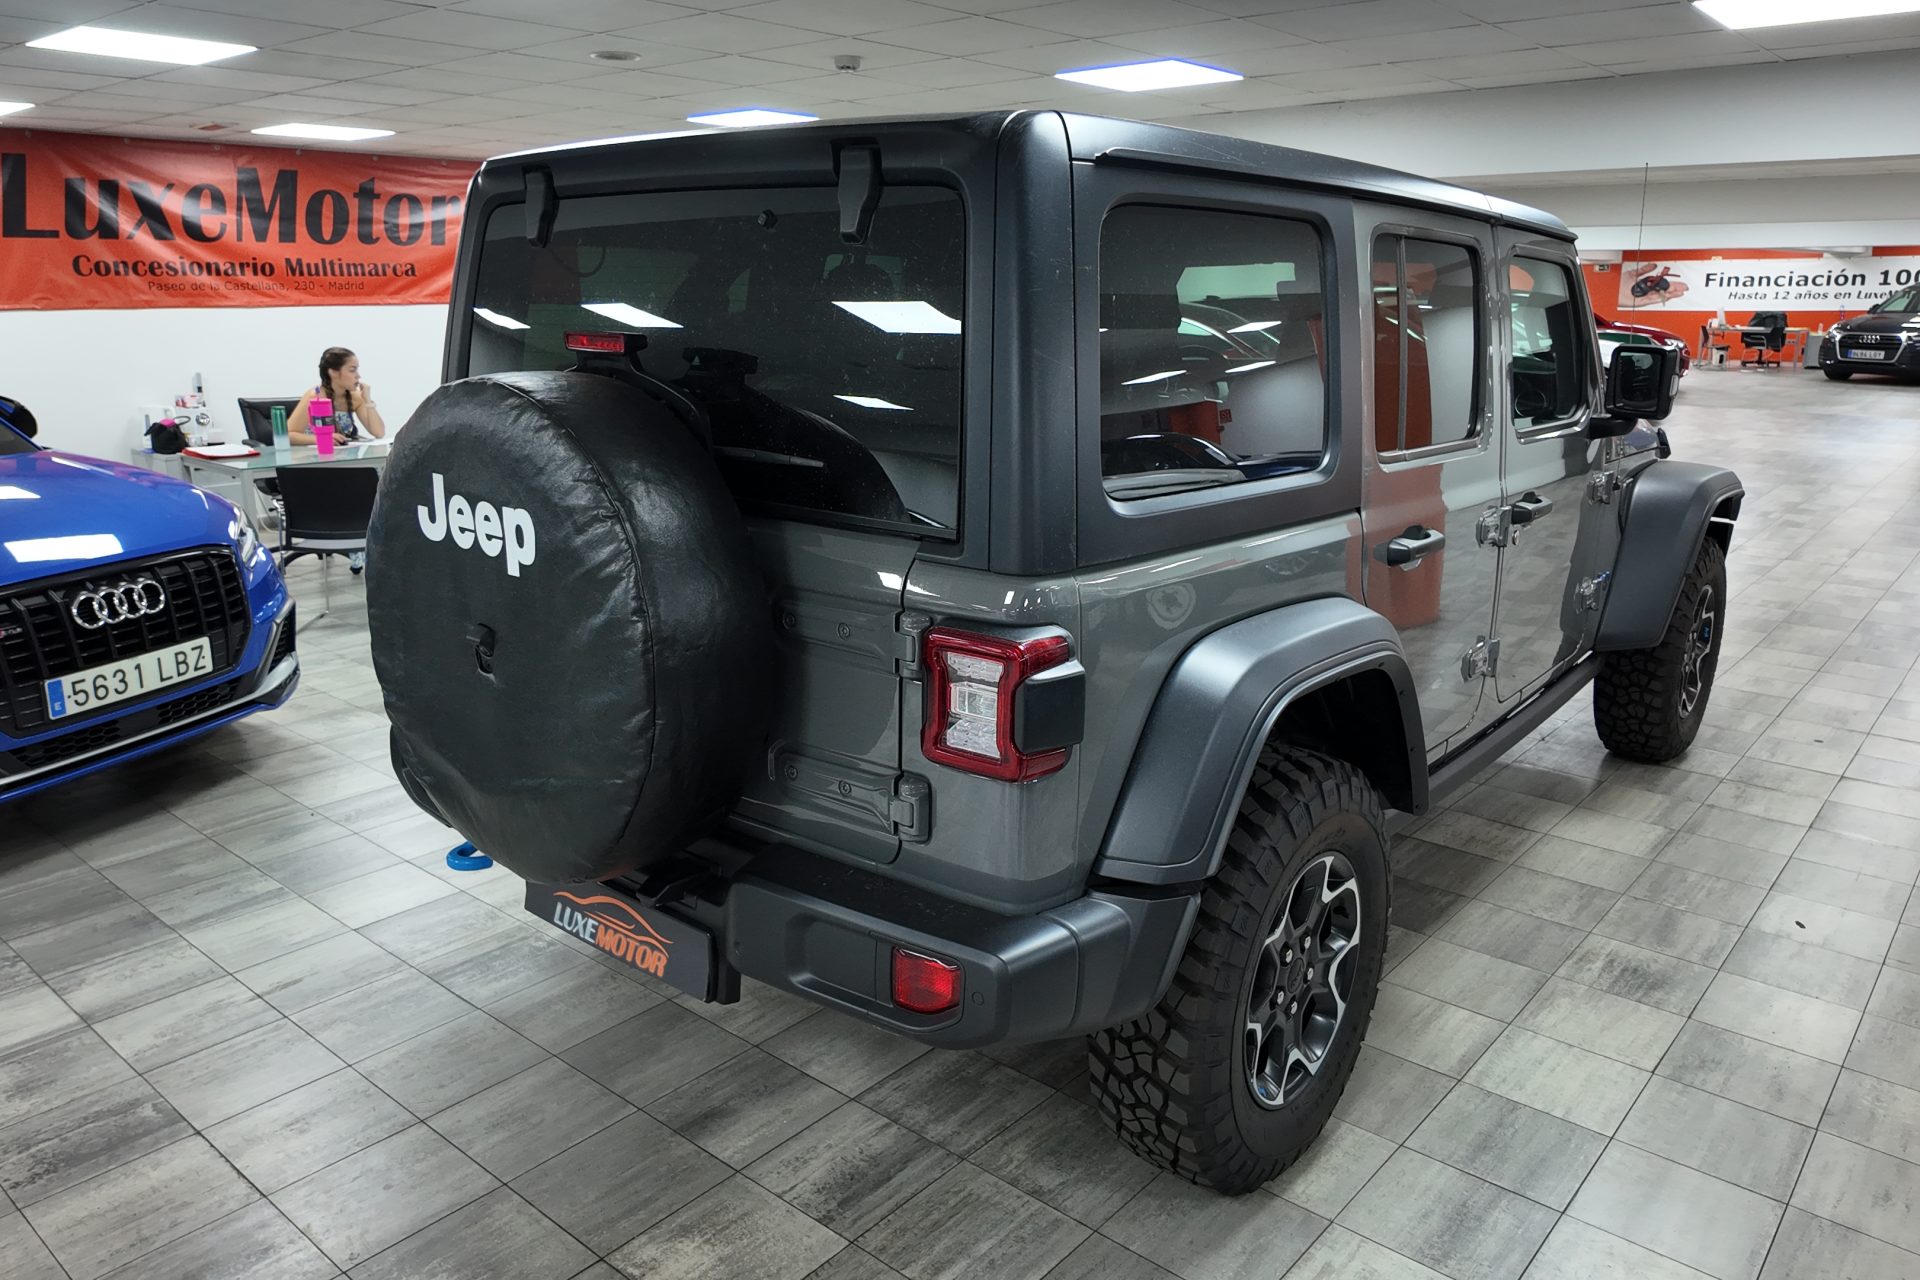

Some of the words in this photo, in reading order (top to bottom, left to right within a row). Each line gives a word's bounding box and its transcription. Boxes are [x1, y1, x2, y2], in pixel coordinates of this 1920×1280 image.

[2, 152, 461, 246] LuxeMotor
[72, 254, 275, 278] Concesionario
[284, 257, 417, 278] Multimarca
[148, 281, 186, 291] Paseo
[190, 281, 206, 291] de
[209, 281, 220, 291] la
[294, 281, 315, 291] 230
[328, 281, 365, 291] Madrid
[1704, 268, 1866, 287] Financiación
[1728, 291, 1767, 300] Hasta
[1773, 291, 1790, 300] 12
[1794, 290, 1828, 300] años
[1834, 291, 1851, 299] en
[417, 472, 536, 578] Jeep
[70, 662, 146, 707] 5631
[156, 644, 207, 683] LBZ
[553, 901, 669, 977] LUXEMOTOR
